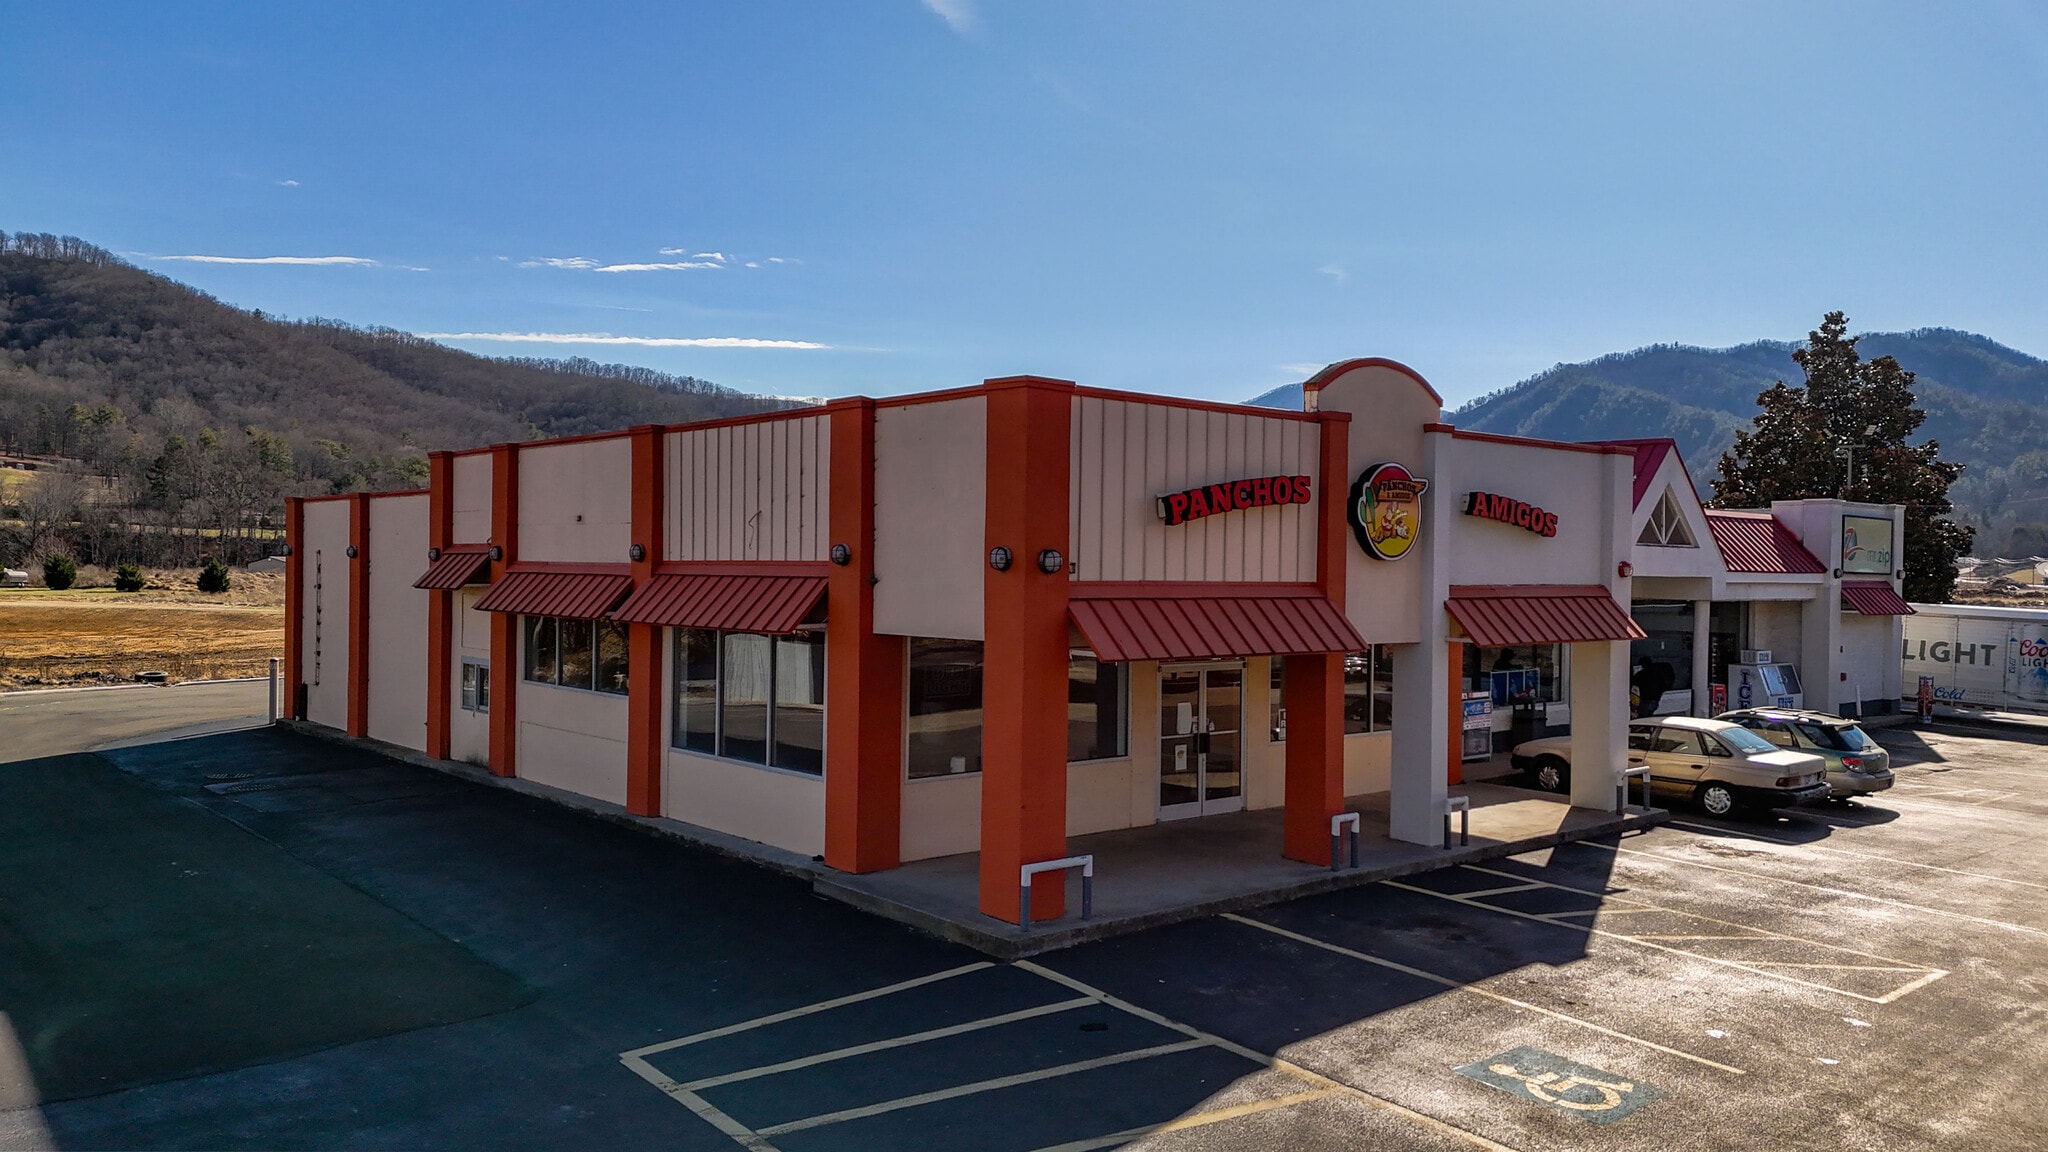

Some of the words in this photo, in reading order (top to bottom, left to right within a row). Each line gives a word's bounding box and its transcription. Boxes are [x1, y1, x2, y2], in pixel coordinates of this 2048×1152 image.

[1382, 480, 1417, 492] PANCHOS
[1392, 491, 1411, 499] AMIGOS
[1169, 475, 1311, 525] PANCHOS
[1472, 491, 1558, 538] AMIGOS
[1902, 638, 1997, 666] LIGHT
[1934, 686, 1966, 701] Cold
